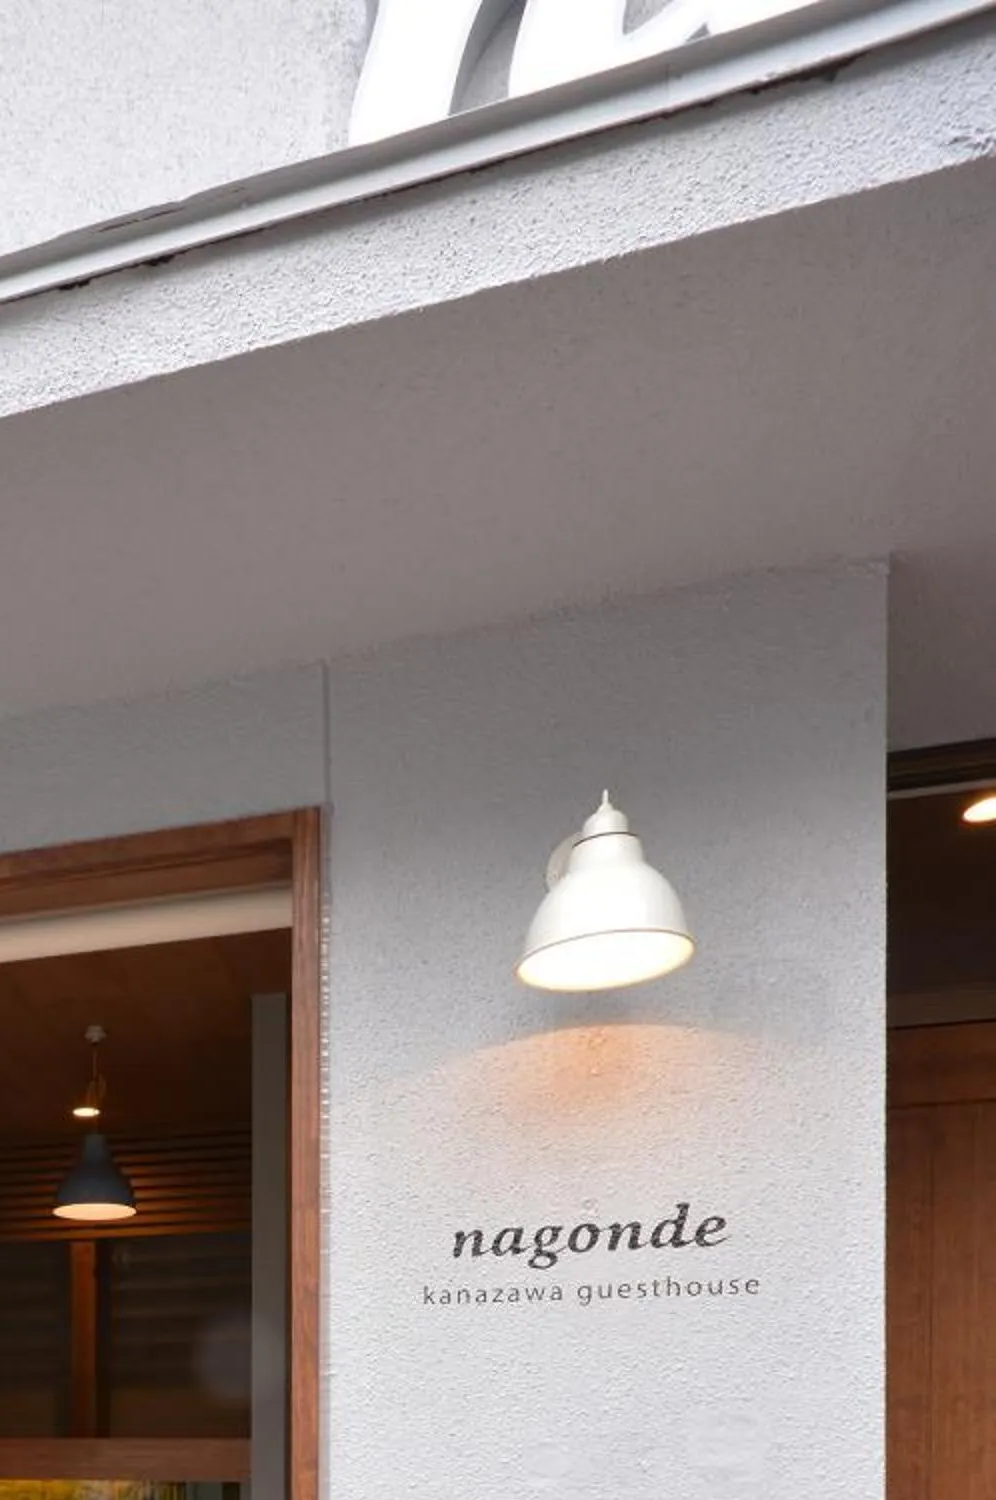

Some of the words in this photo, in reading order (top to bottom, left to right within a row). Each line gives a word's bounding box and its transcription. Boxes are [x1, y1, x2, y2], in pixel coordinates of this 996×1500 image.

[452, 1202, 729, 1270] nagonde
[422, 1283, 564, 1306] kanazawa
[576, 1275, 761, 1307] guesthouse
